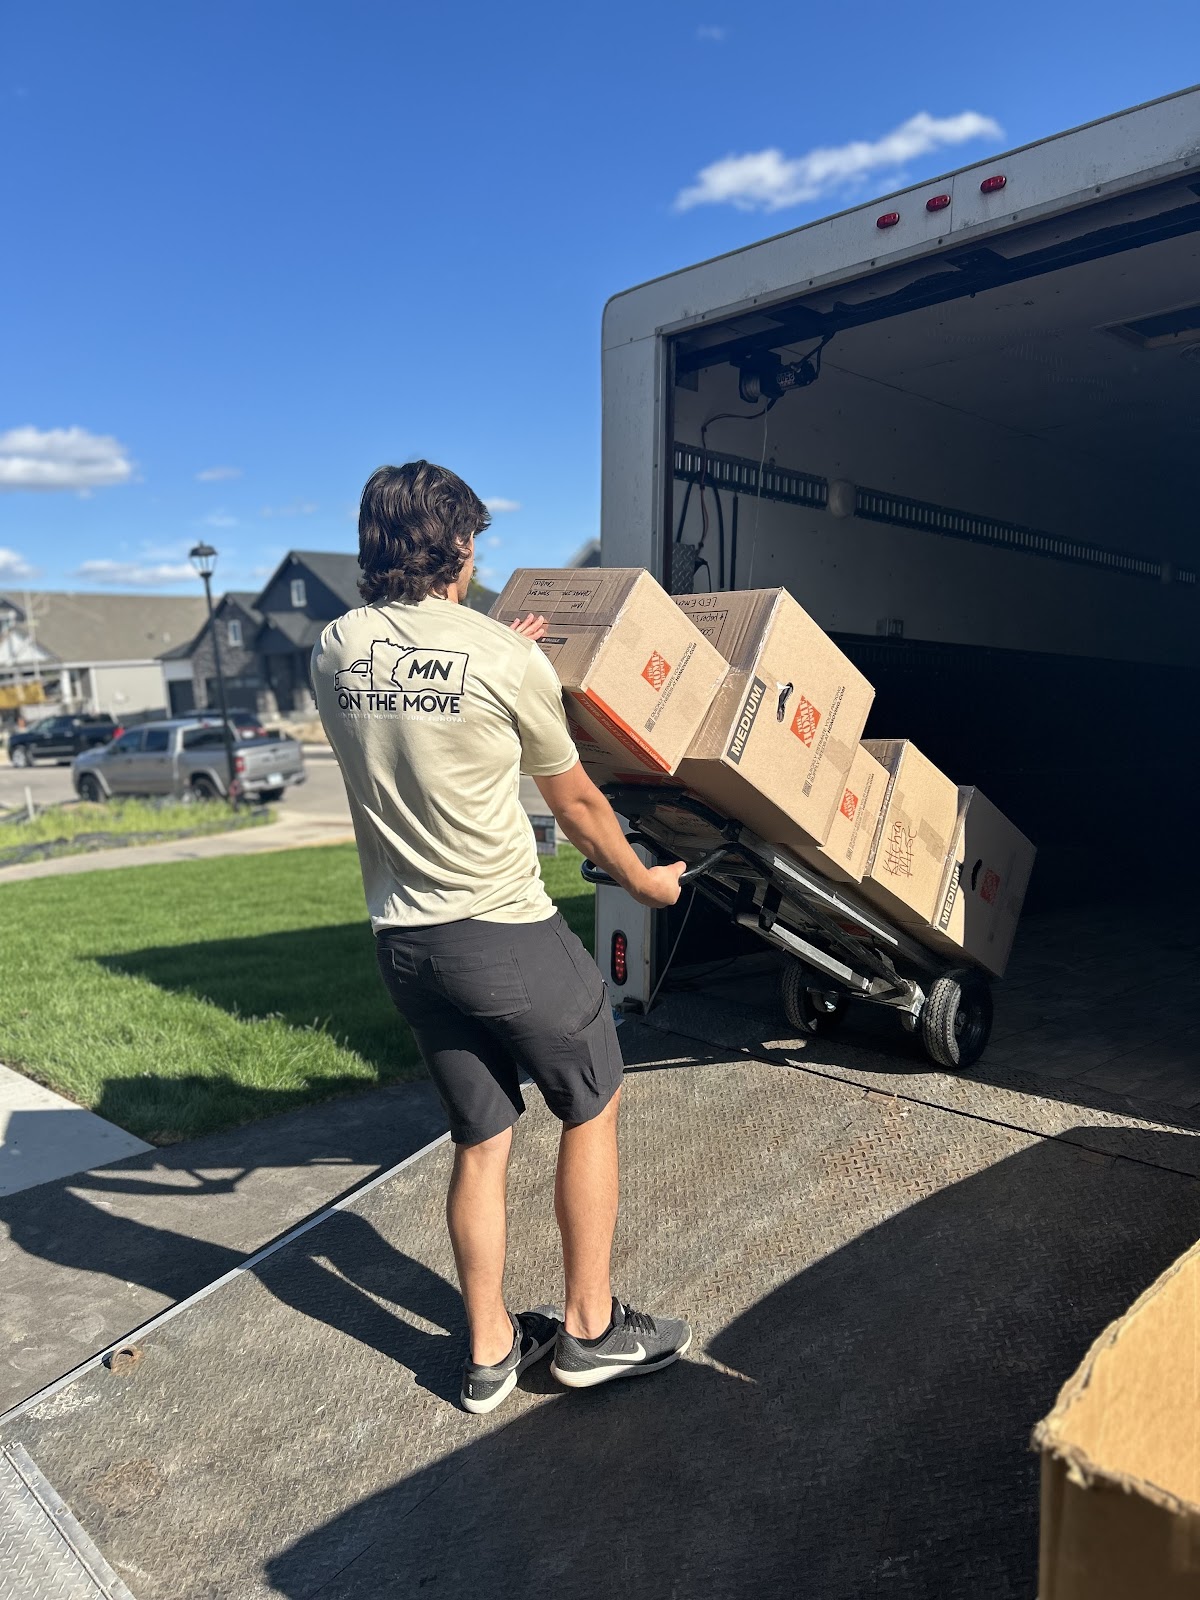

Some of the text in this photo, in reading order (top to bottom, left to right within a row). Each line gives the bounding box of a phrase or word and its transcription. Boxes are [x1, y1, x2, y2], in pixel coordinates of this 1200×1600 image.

[698, 596, 717, 608] LED
[407, 659, 454, 680] MN
[338, 692, 460, 714] ON THE MOVE
[731, 684, 763, 757] MEDIUM
[800, 698, 812, 746] HOME
[941, 866, 960, 925] MEDIUM
